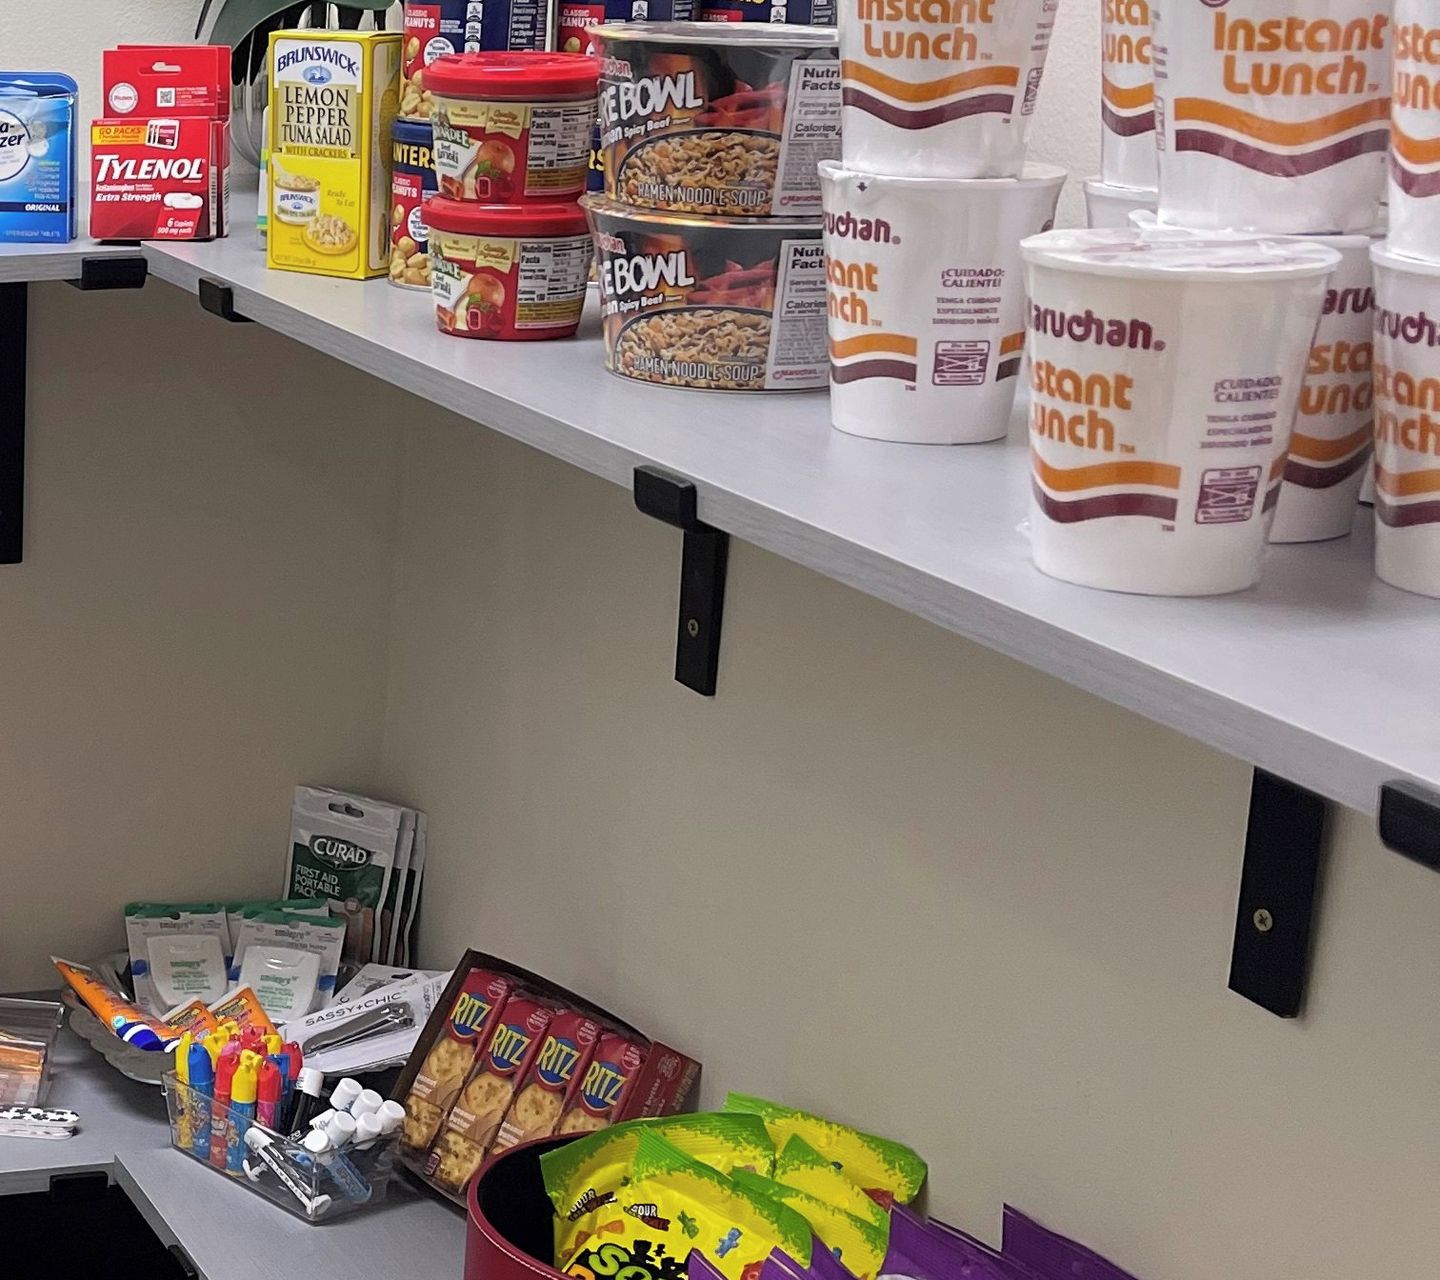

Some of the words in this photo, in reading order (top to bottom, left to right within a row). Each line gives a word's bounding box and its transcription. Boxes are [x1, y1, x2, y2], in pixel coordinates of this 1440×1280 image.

[864, 23, 977, 61] Lunch
[1214, 11, 1389, 52] Instant
[278, 46, 357, 77] BRUNSWICK
[1223, 55, 1368, 96] Lunch
[285, 86, 349, 107] LEMON
[620, 72, 704, 121] BOWL
[286, 106, 349, 127] PEPPER
[532, 121, 550, 129] Facts
[624, 124, 646, 139] Spicy
[647, 116, 670, 132] Beef
[795, 123, 836, 132] Calories
[282, 124, 311, 144] TUNA
[316, 125, 351, 146] SALAD
[285, 146, 306, 156] WITH
[308, 147, 348, 158] CRACKERS
[95, 154, 203, 182] TYLENOL
[96, 193, 120, 202] Extra
[121, 193, 161, 203] Strength
[638, 184, 673, 202] RAMEN
[676, 186, 725, 206] NOODLE
[731, 190, 767, 207] SOUP
[521, 245, 551, 254] Nutrition
[521, 256, 540, 264] Facts
[615, 251, 694, 296] BOWL
[619, 300, 640, 313] Spicy
[641, 294, 663, 308] Beef
[634, 357, 668, 376] RAMEN
[670, 362, 719, 381] NOODLE
[724, 364, 759, 381] SOUP
[314, 838, 367, 864] CURAD
[295, 874, 340, 896] PORTABLE
[296, 864, 320, 878] FIRST
[322, 872, 338, 885] AID
[294, 884, 317, 898] PACK
[450, 992, 492, 1032] RITZ
[488, 1024, 532, 1066] RITZ
[535, 1035, 582, 1080] RITZ
[583, 1060, 627, 1106] RITZ
